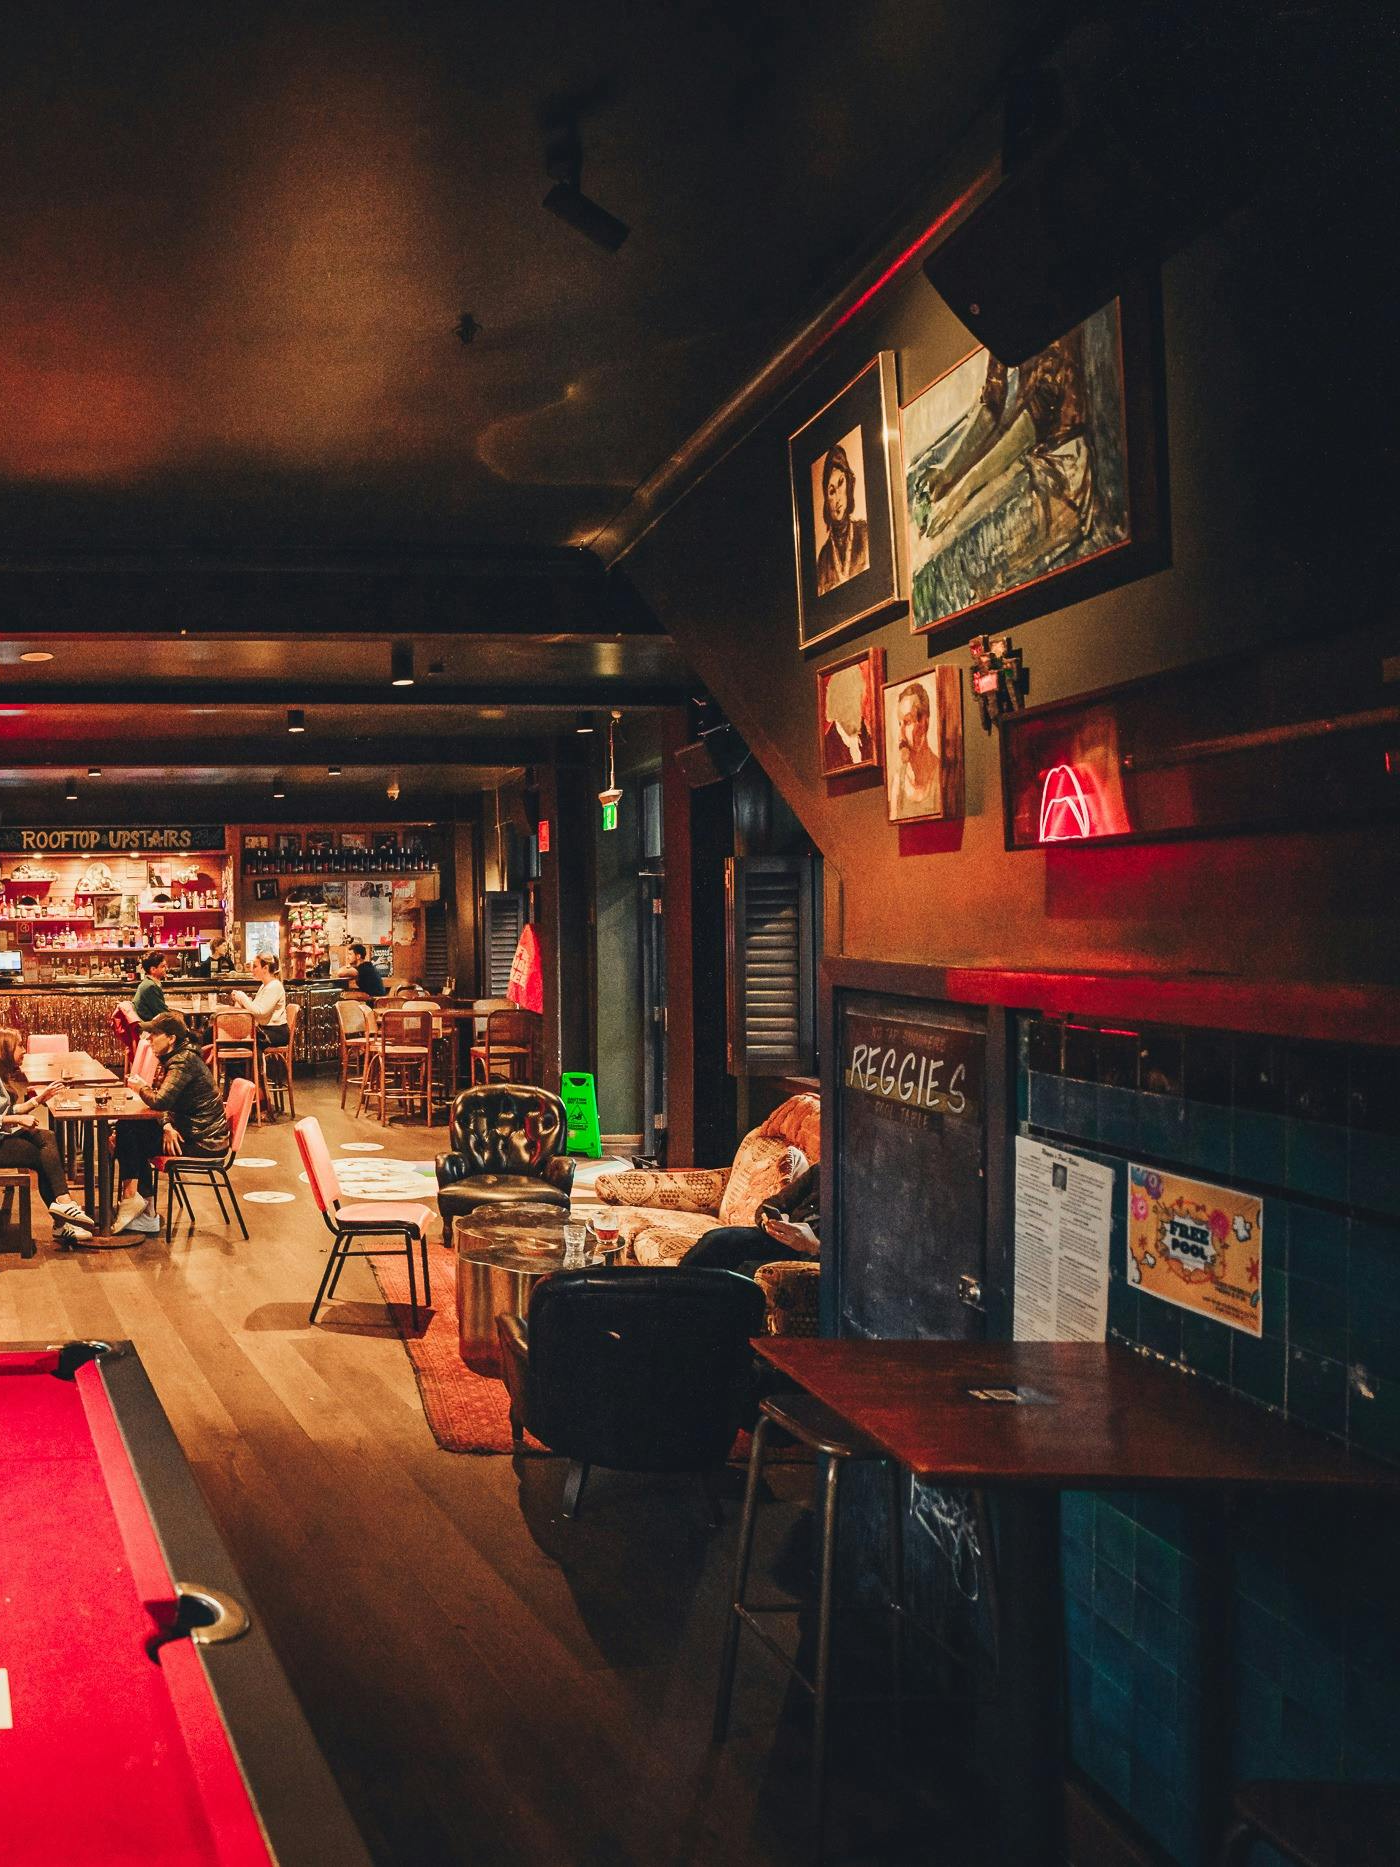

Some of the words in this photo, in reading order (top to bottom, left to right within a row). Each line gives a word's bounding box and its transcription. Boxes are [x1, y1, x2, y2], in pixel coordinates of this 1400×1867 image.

[21, 830, 99, 849] ROOFTOP
[109, 830, 192, 849] UPSTAIRS
[1170, 1220, 1210, 1246] FREE
[1171, 1237, 1209, 1261] POOL
